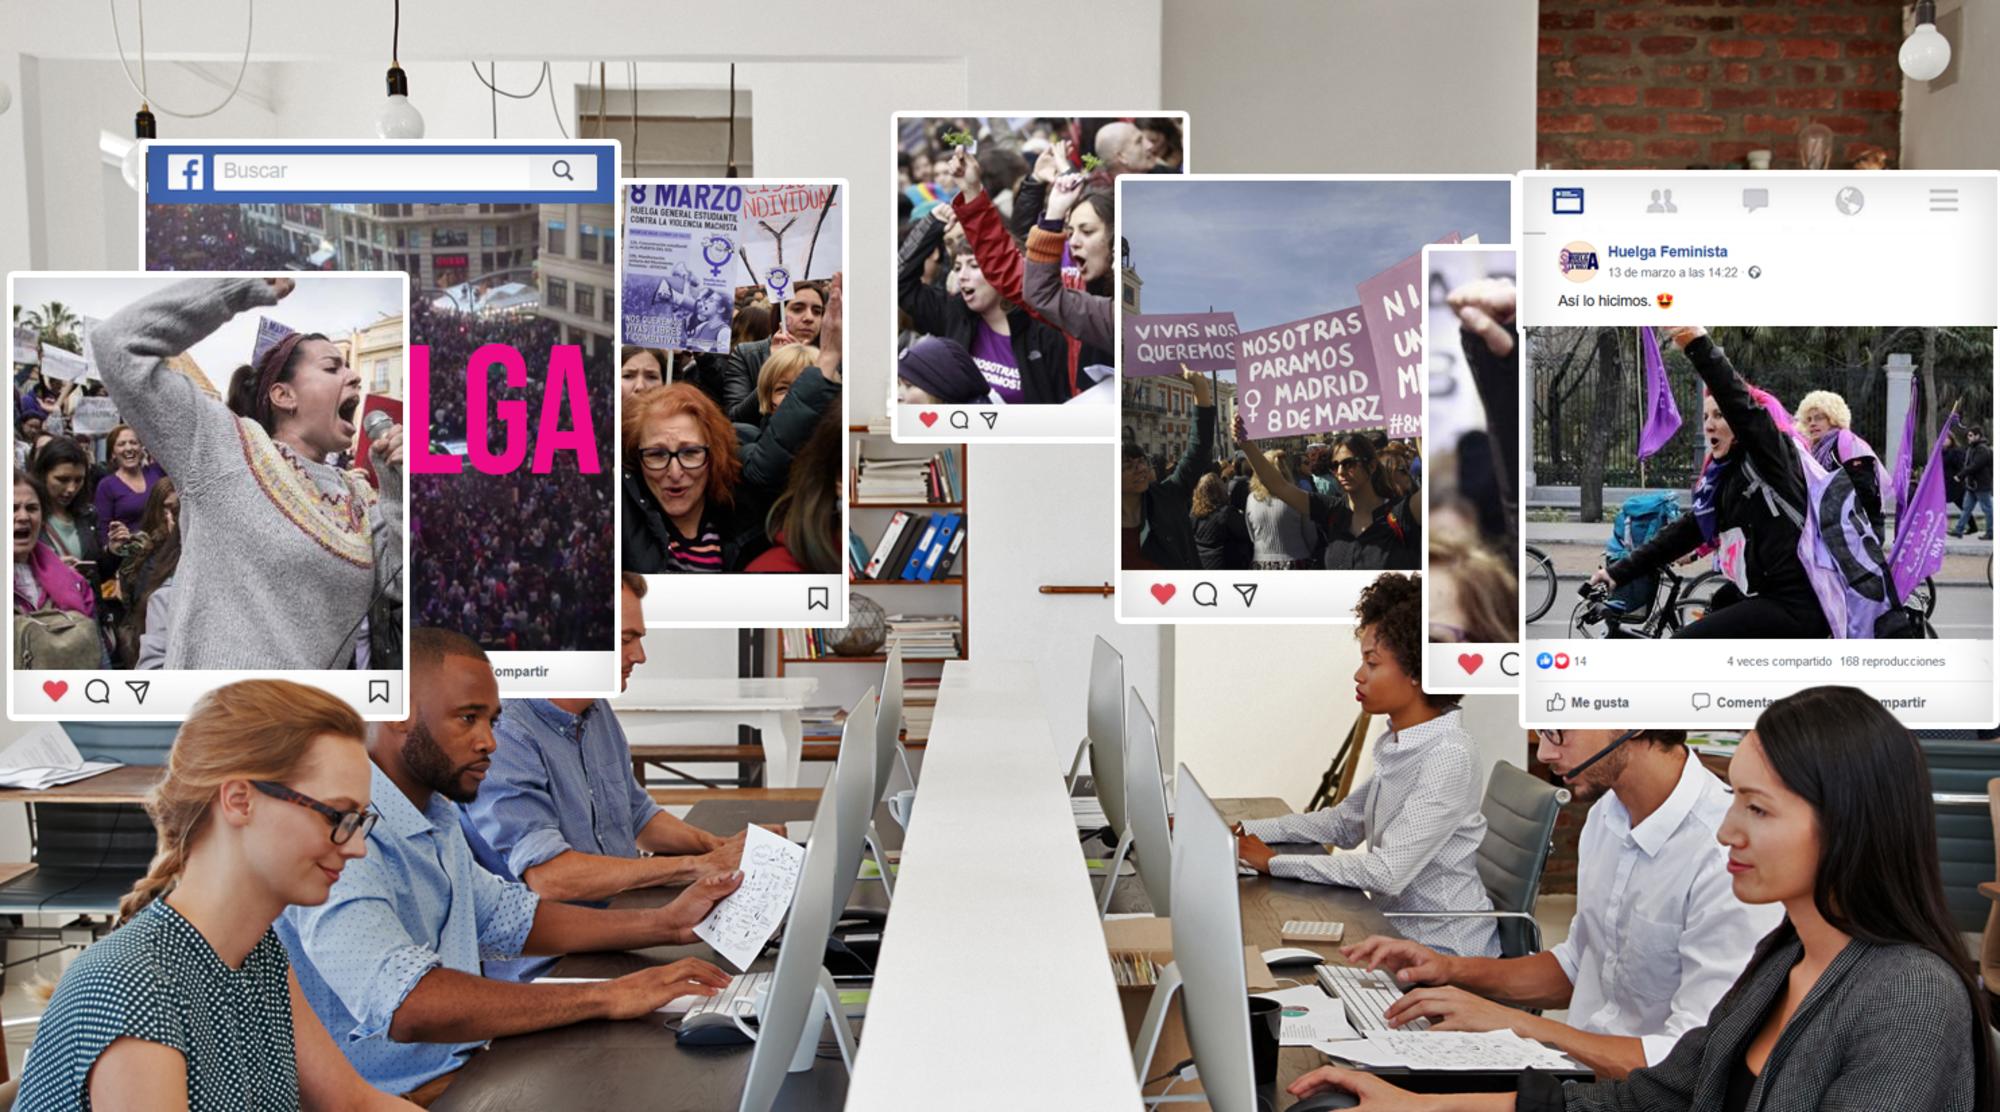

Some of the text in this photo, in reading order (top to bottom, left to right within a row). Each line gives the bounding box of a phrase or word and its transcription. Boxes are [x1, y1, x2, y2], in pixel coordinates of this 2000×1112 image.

[630, 185, 646, 204] 8
[655, 185, 742, 212] MARZO
[630, 206, 738, 222] HUELGA GENERAL ESTUDIANTIL
[630, 216, 738, 232] CONTRA LA VIOLENCIA MACHISTA
[1135, 323, 1239, 340] VIVAS NOS
[1242, 313, 1362, 358] NOSOTRAS
[1137, 342, 1235, 364] QUEREMOS
[1250, 343, 1354, 382] PARAMOS
[1275, 370, 1369, 406] MADRID
[1268, 395, 1384, 432] 8 DE MARZ
